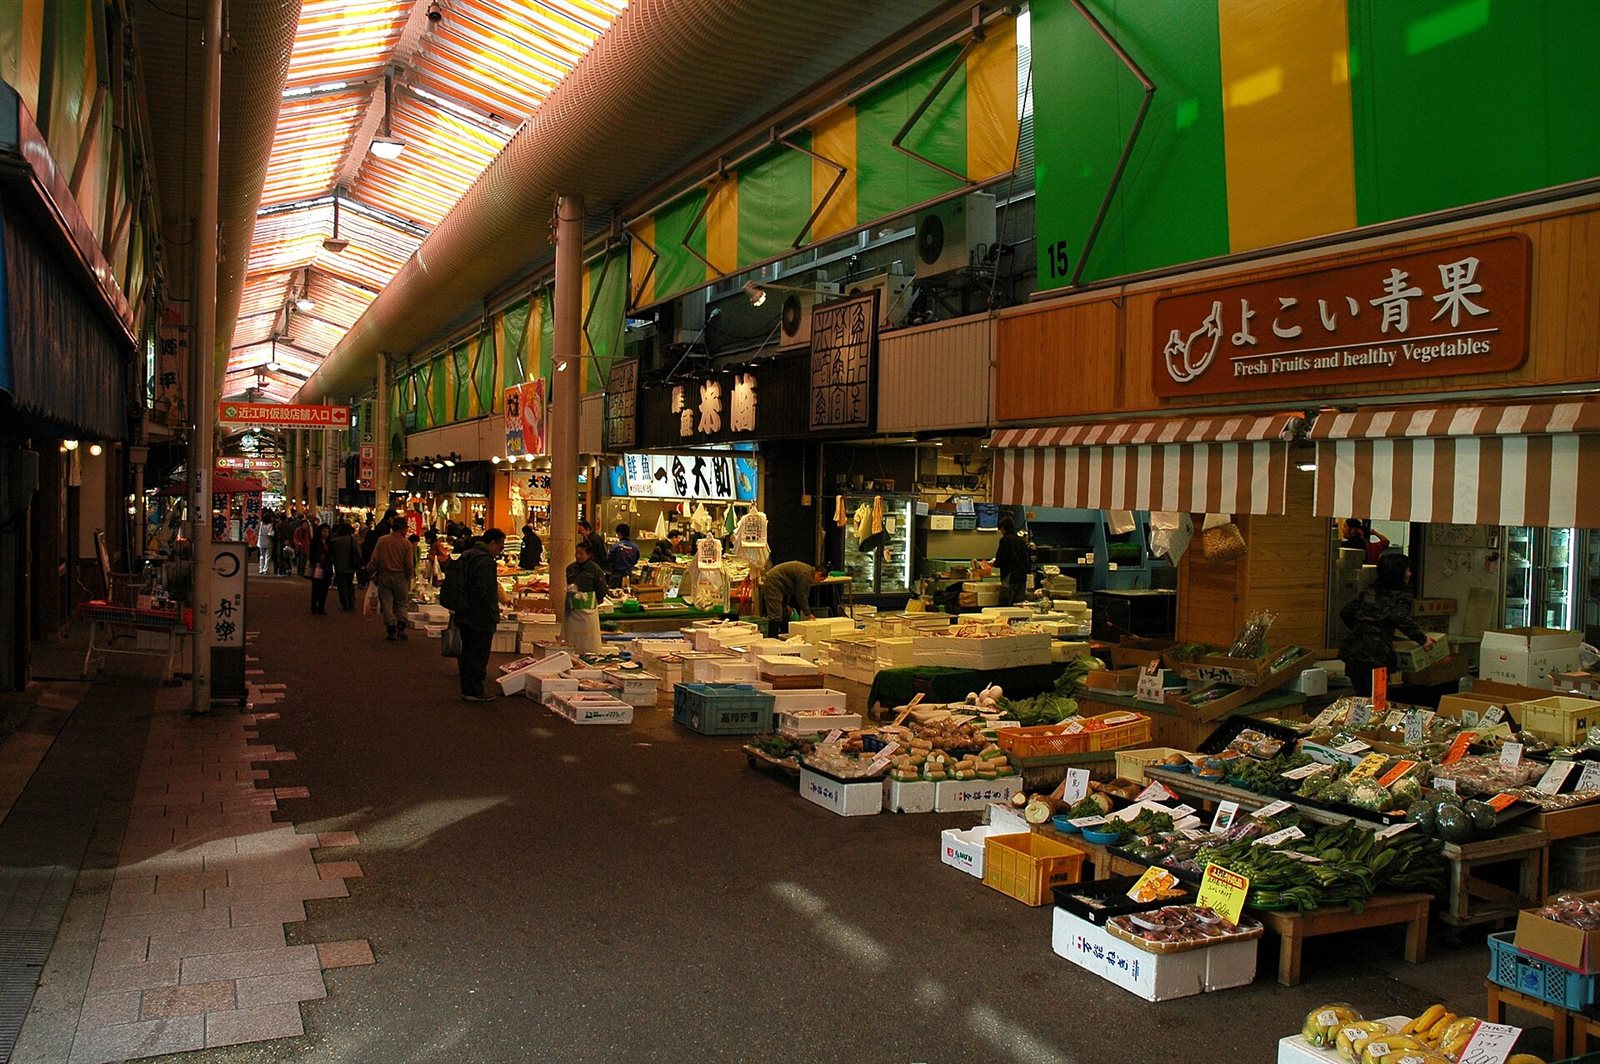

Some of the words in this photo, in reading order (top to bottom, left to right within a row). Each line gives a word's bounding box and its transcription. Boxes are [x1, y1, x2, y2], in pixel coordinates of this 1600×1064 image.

[1047, 240, 1069, 279] 15
[1231, 256, 1489, 346] よこい青果
[1233, 358, 1268, 377] Fresh
[1271, 355, 1310, 374] Fruits
[1313, 353, 1340, 369] and
[1343, 347, 1397, 369] healthy
[1401, 338, 1490, 364] Vegetables
[238, 406, 330, 421] 近江町仮設店舗入口
[1082, 937, 1129, 971] 万能ねぎ
